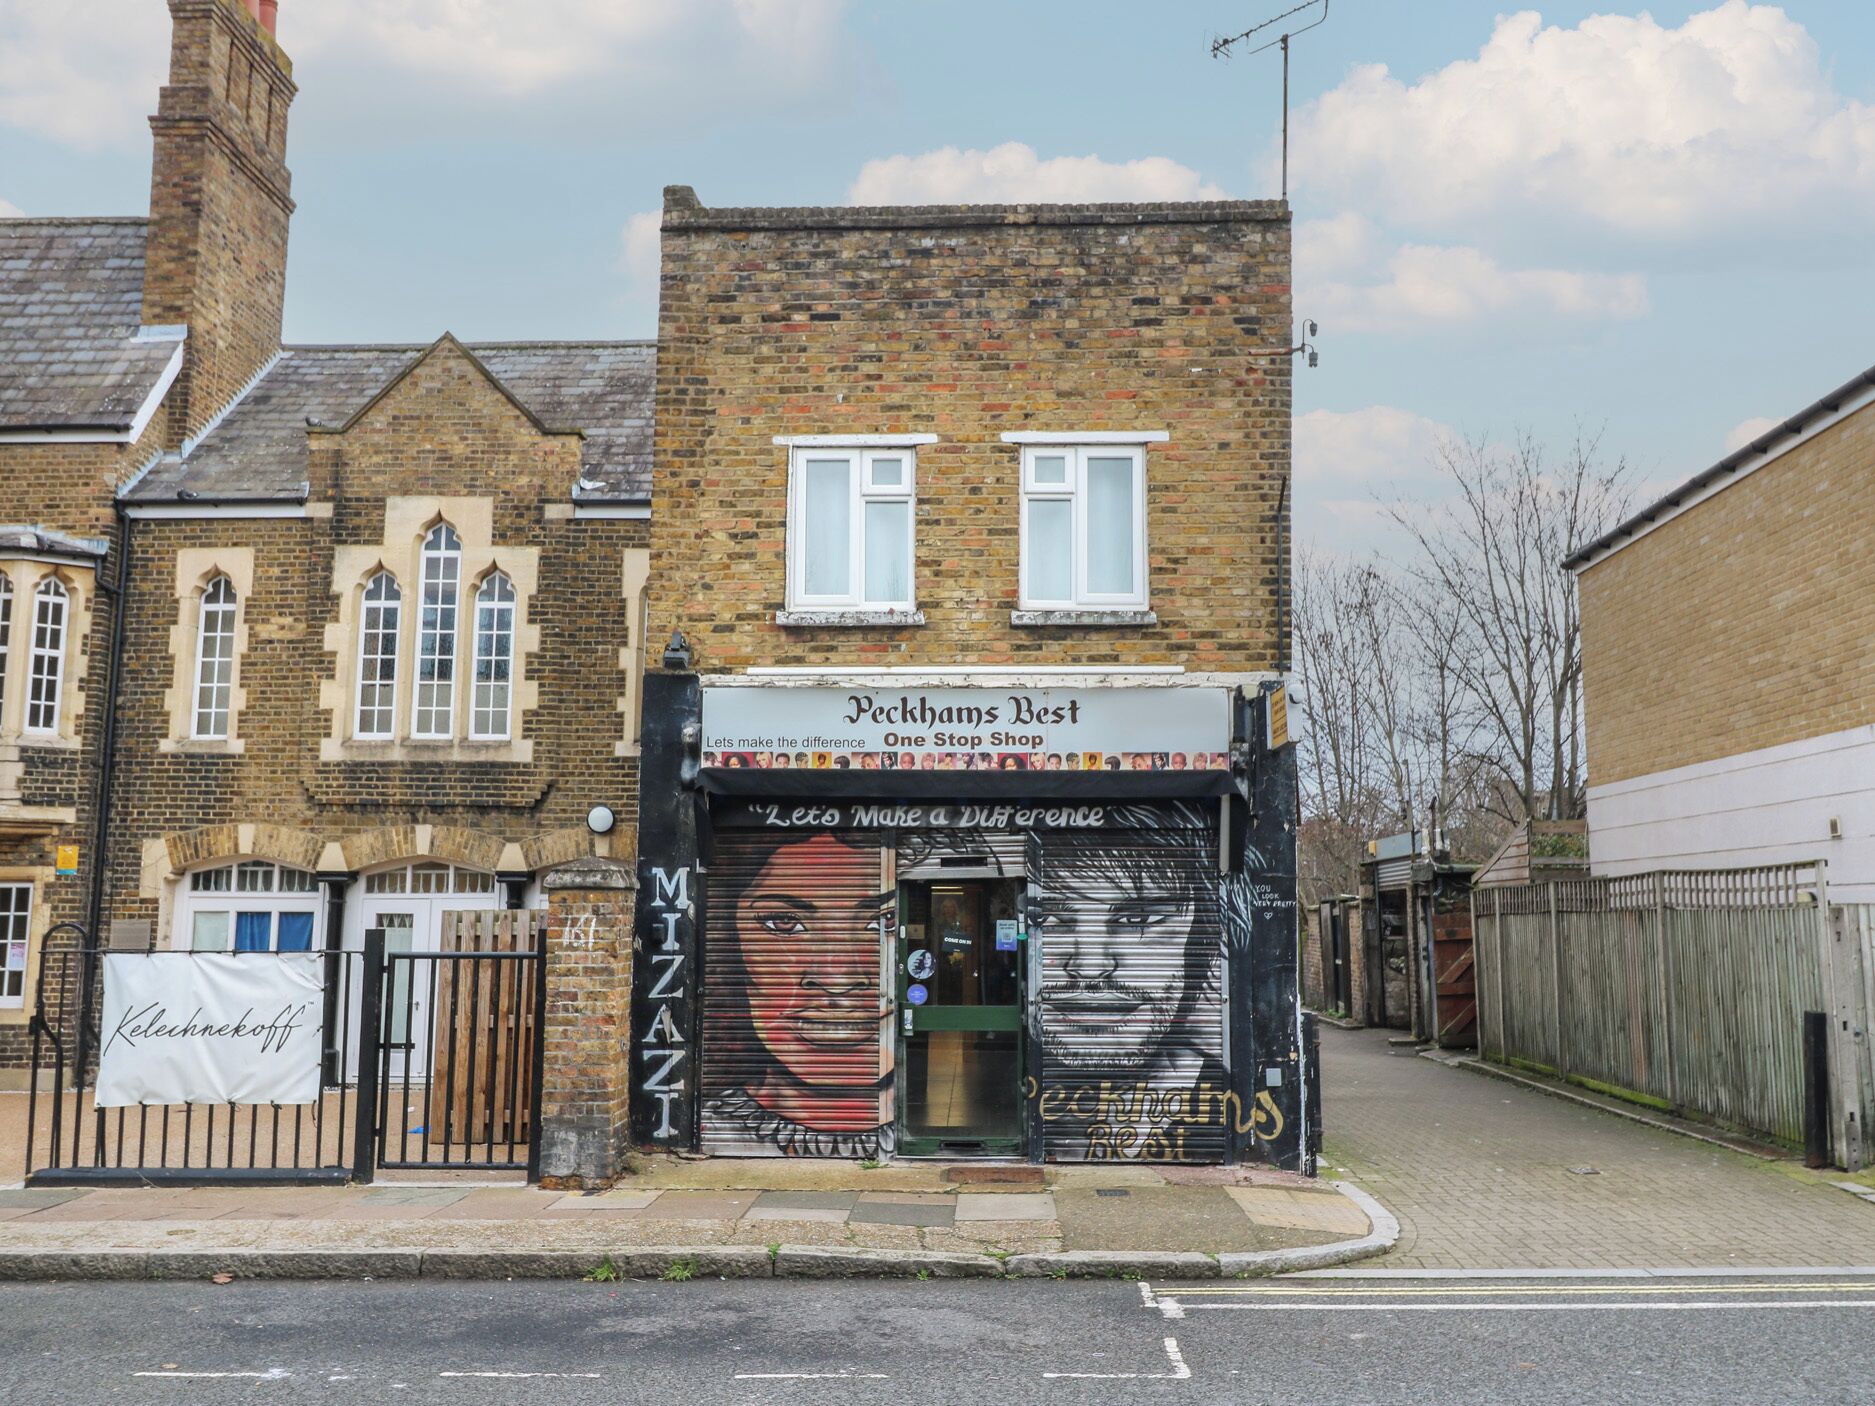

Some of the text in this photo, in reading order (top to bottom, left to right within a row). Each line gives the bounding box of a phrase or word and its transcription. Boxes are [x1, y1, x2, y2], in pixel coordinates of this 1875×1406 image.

[843, 695, 1081, 730] Peckhams Best
[706, 735, 865, 749] Lets make the difference
[884, 731, 1044, 750] One Stop Shop
[851, 805, 922, 827] Make
[929, 807, 949, 825] a
[1255, 884, 1271, 892] YOU
[642, 867, 691, 1138] MIZAZI
[103, 1002, 306, 1057] Kelechnekoff
[1085, 1122, 1191, 1160] Best
